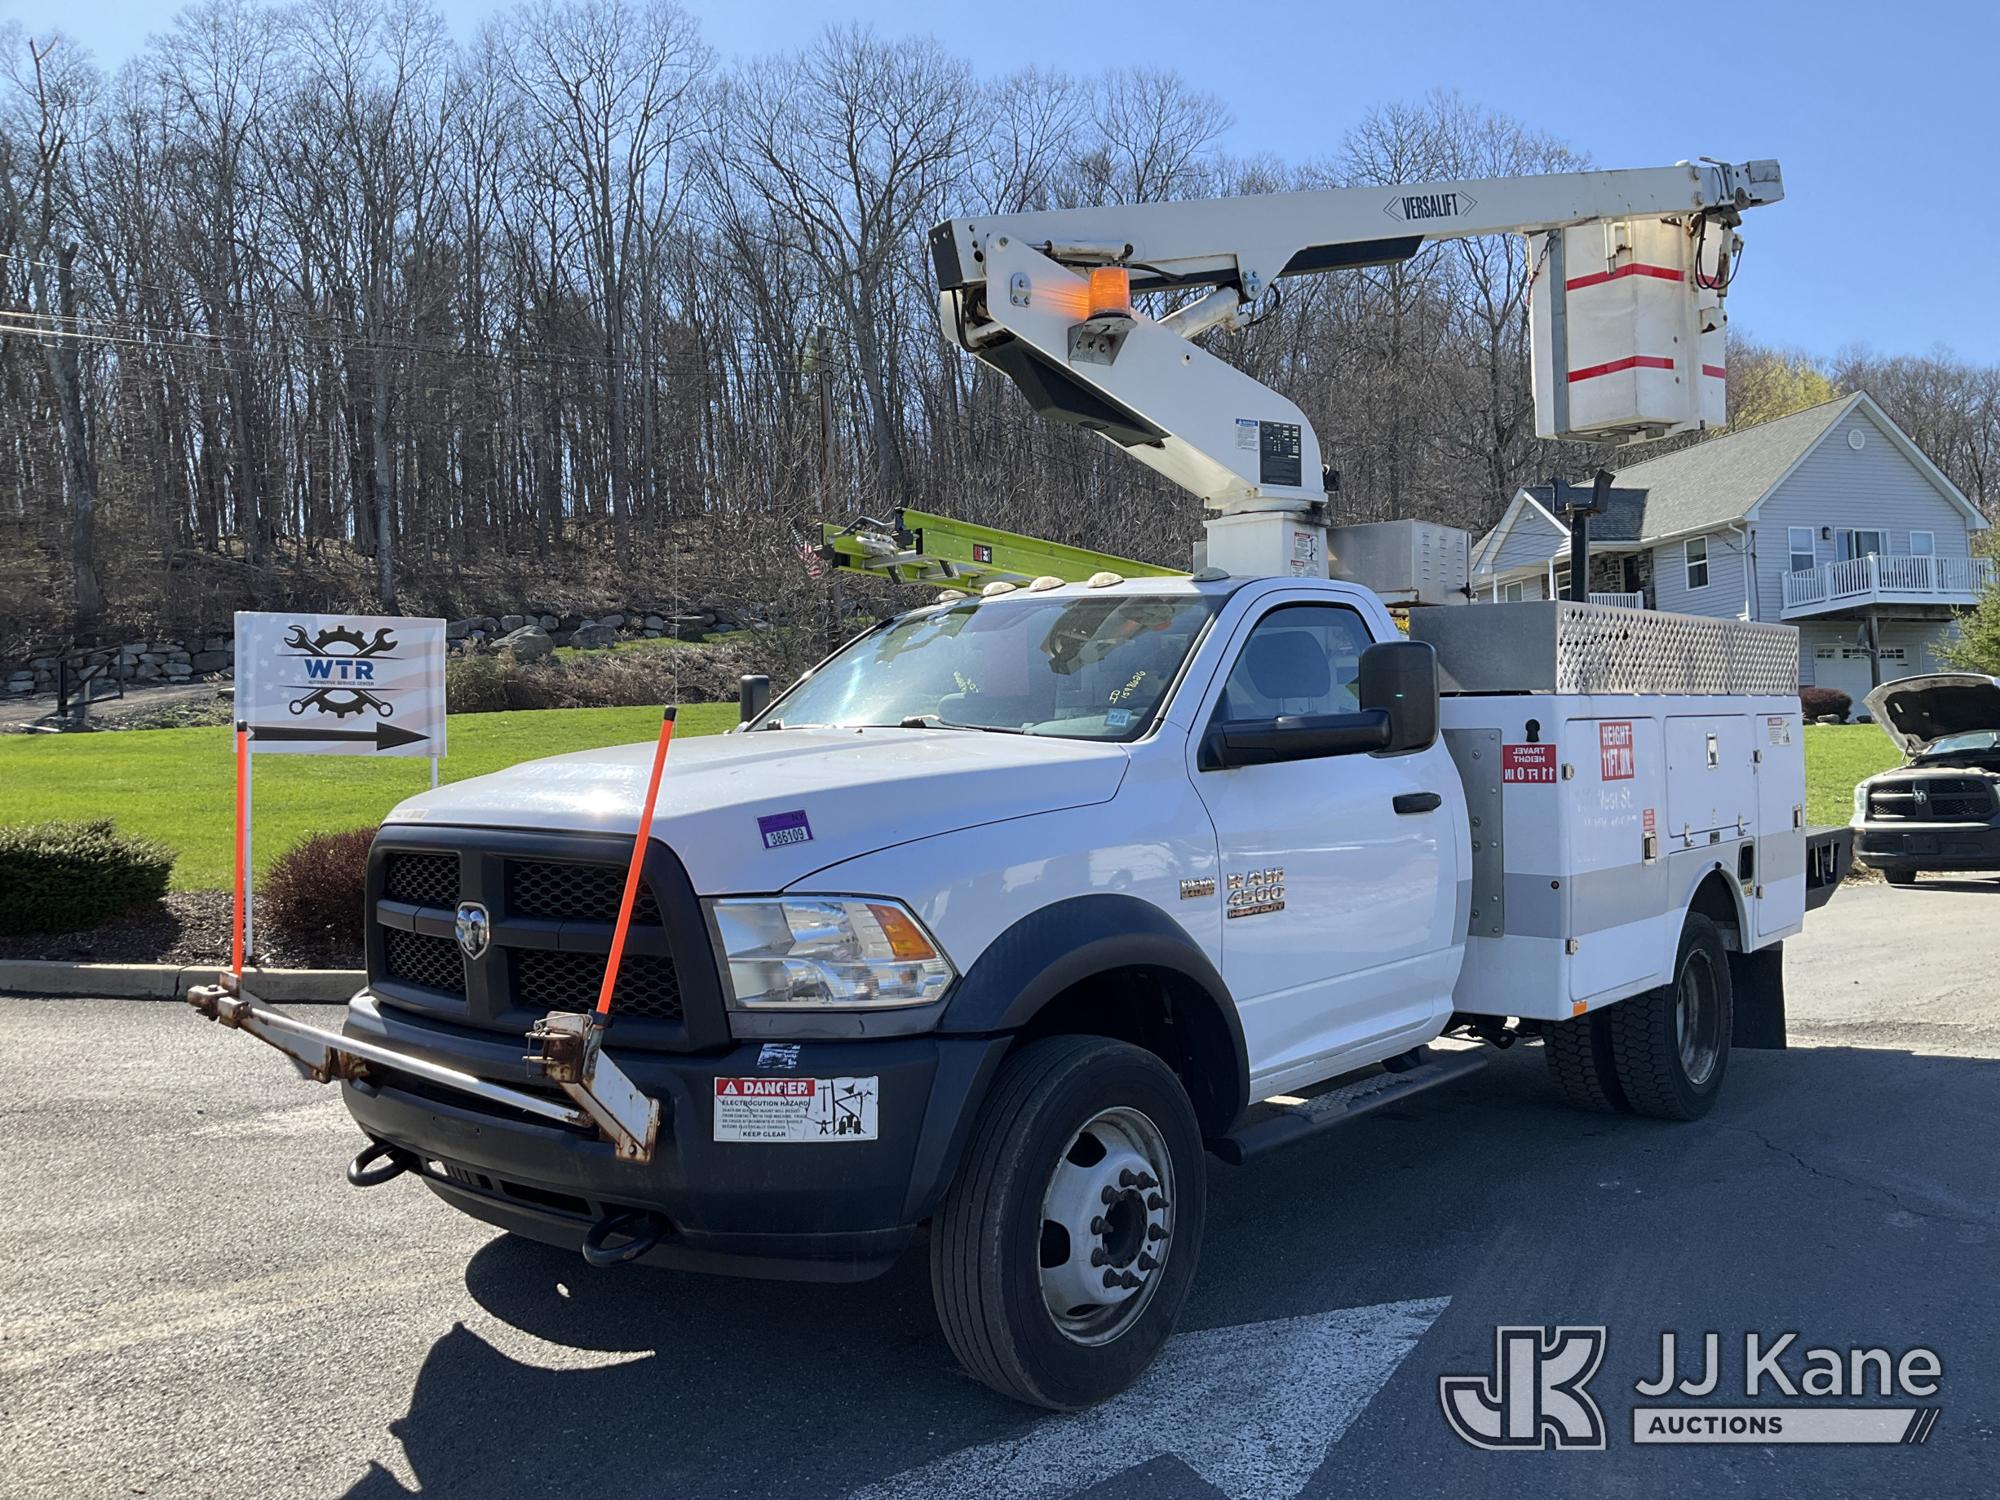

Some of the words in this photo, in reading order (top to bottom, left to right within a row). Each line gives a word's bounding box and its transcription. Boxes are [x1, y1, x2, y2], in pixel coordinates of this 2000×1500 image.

[1402, 193, 1458, 220] VERSALIFT
[304, 658, 375, 680] WTR
[1602, 725, 1630, 745] HEIGHT
[770, 827, 805, 845] 386109
[743, 1081, 808, 1095] DANGER
